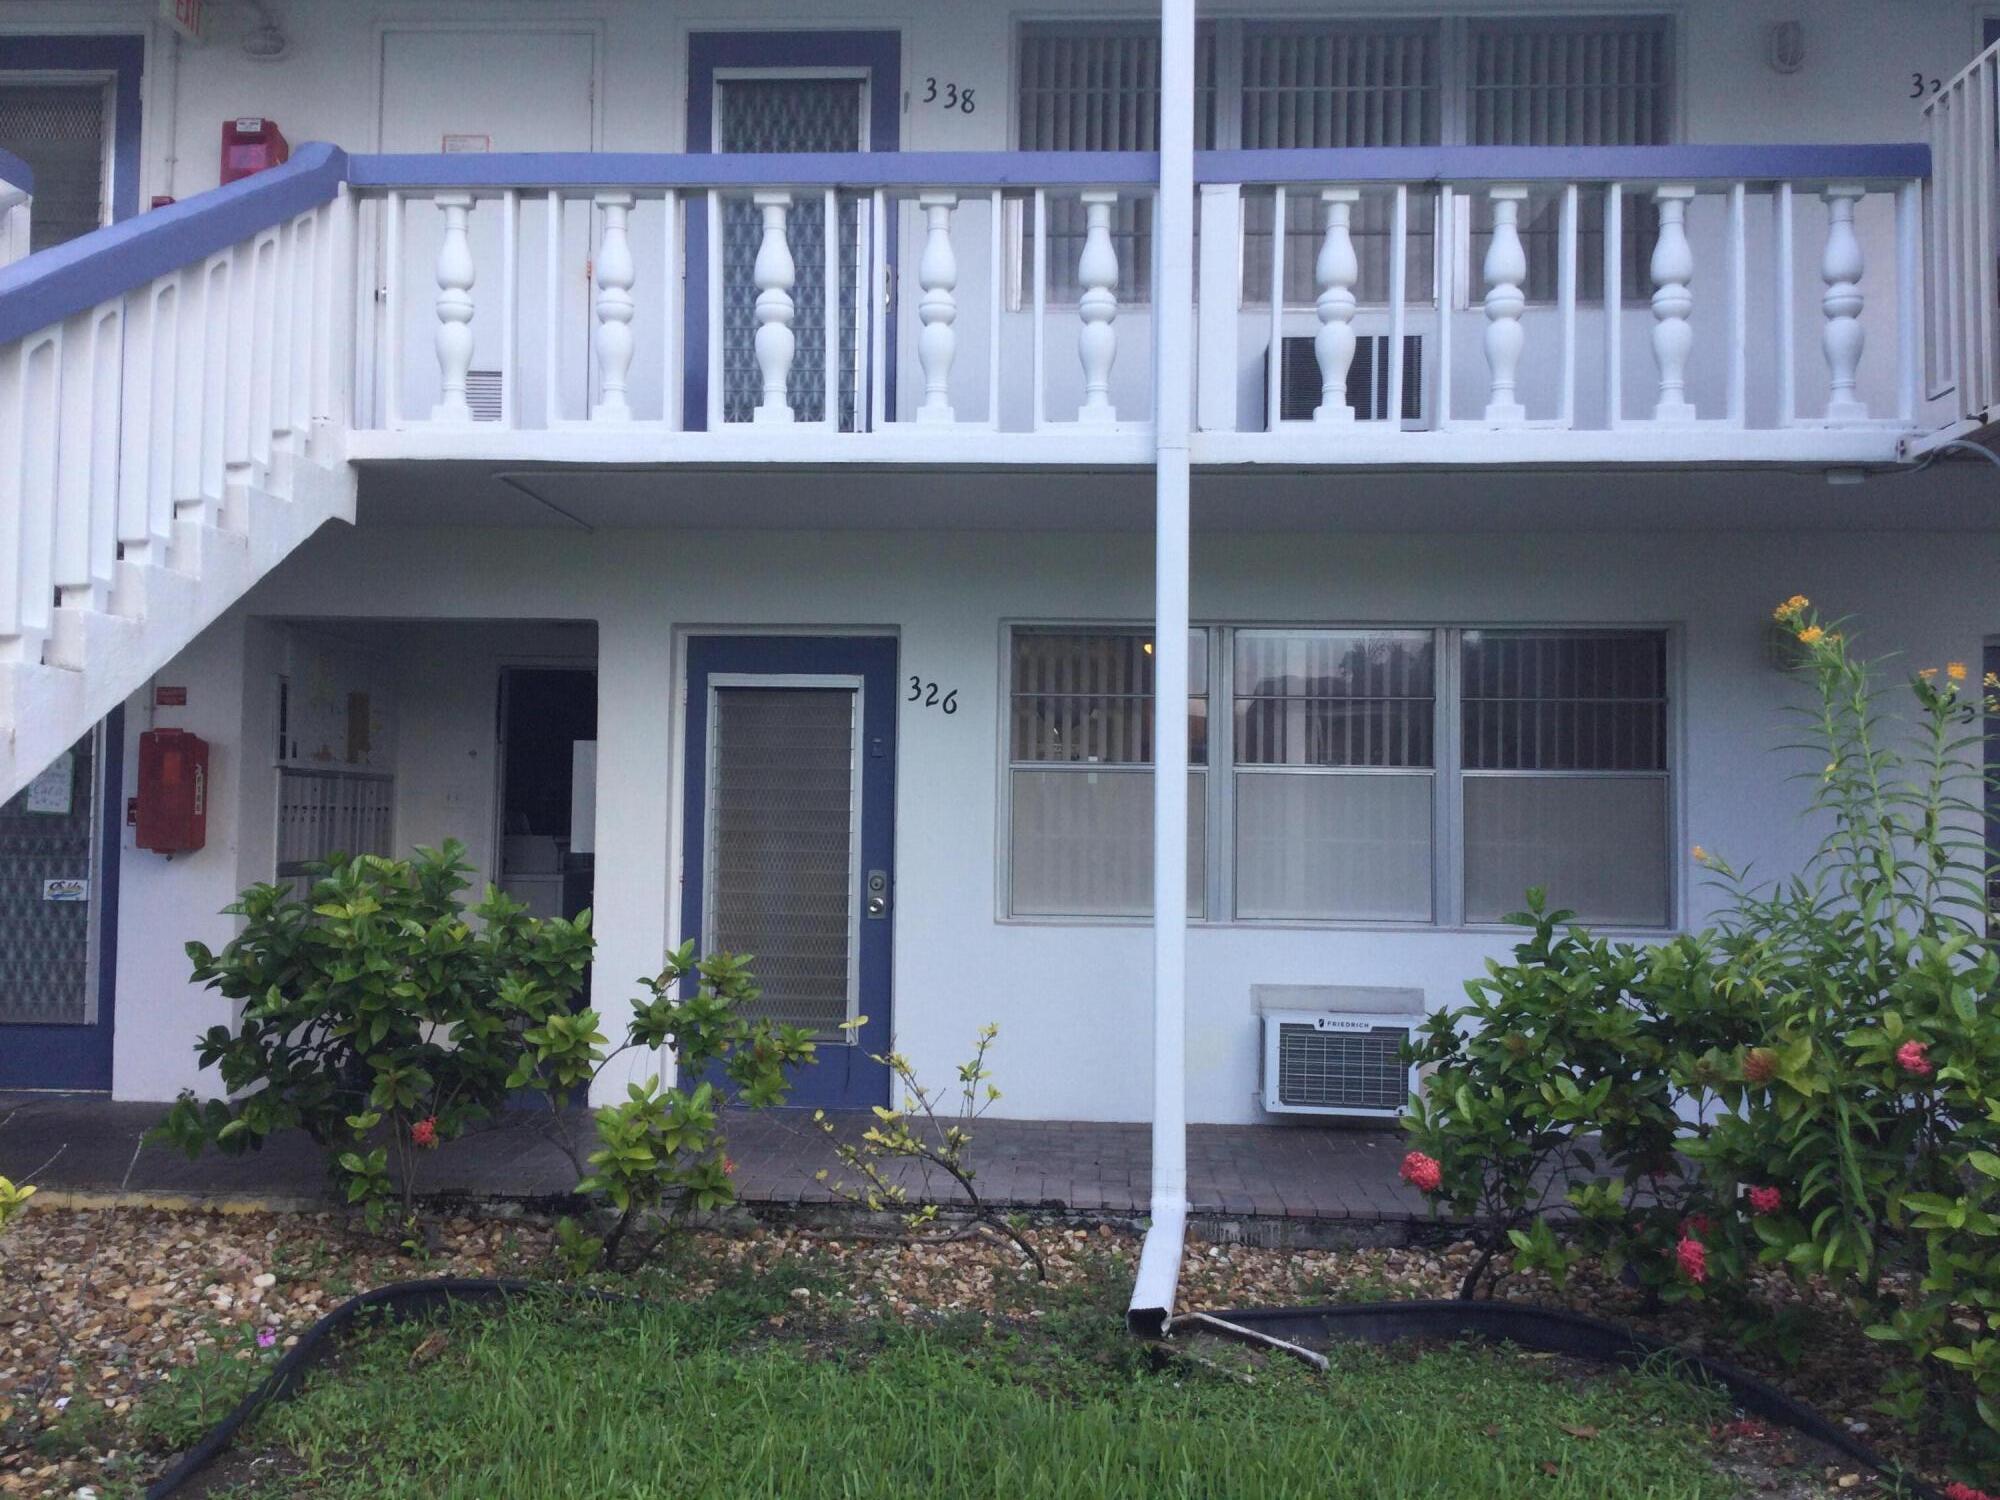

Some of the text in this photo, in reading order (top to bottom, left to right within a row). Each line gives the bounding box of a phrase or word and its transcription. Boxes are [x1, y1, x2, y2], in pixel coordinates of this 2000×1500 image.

[923, 77, 975, 114] 338
[908, 675, 958, 714] 326
[1327, 1020, 1369, 1028] FRIEDRICH
